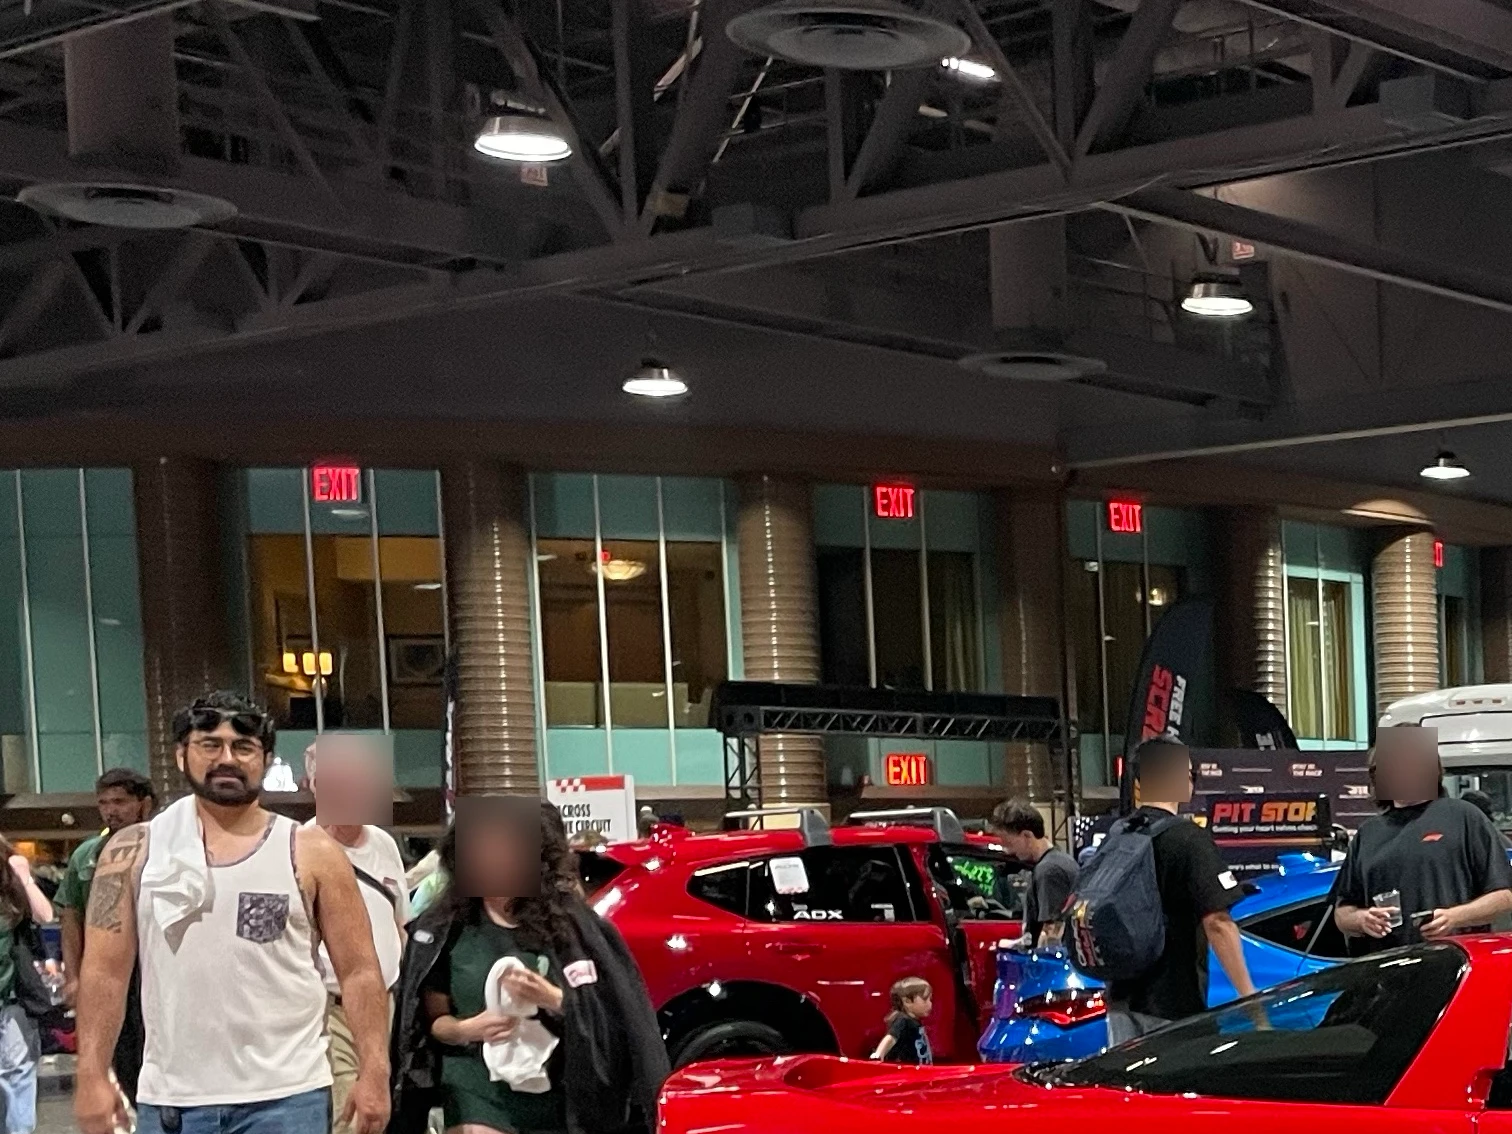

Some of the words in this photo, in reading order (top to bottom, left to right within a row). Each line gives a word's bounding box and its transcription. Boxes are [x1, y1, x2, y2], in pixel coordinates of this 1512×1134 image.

[314, 468, 359, 500] EXIT
[876, 487, 914, 517] EXIT
[1110, 503, 1141, 531] EXIT
[1169, 674, 1187, 725] FREE
[888, 756, 926, 785] EXIT
[1213, 803, 1256, 823] PIT
[793, 910, 844, 920] ADX
